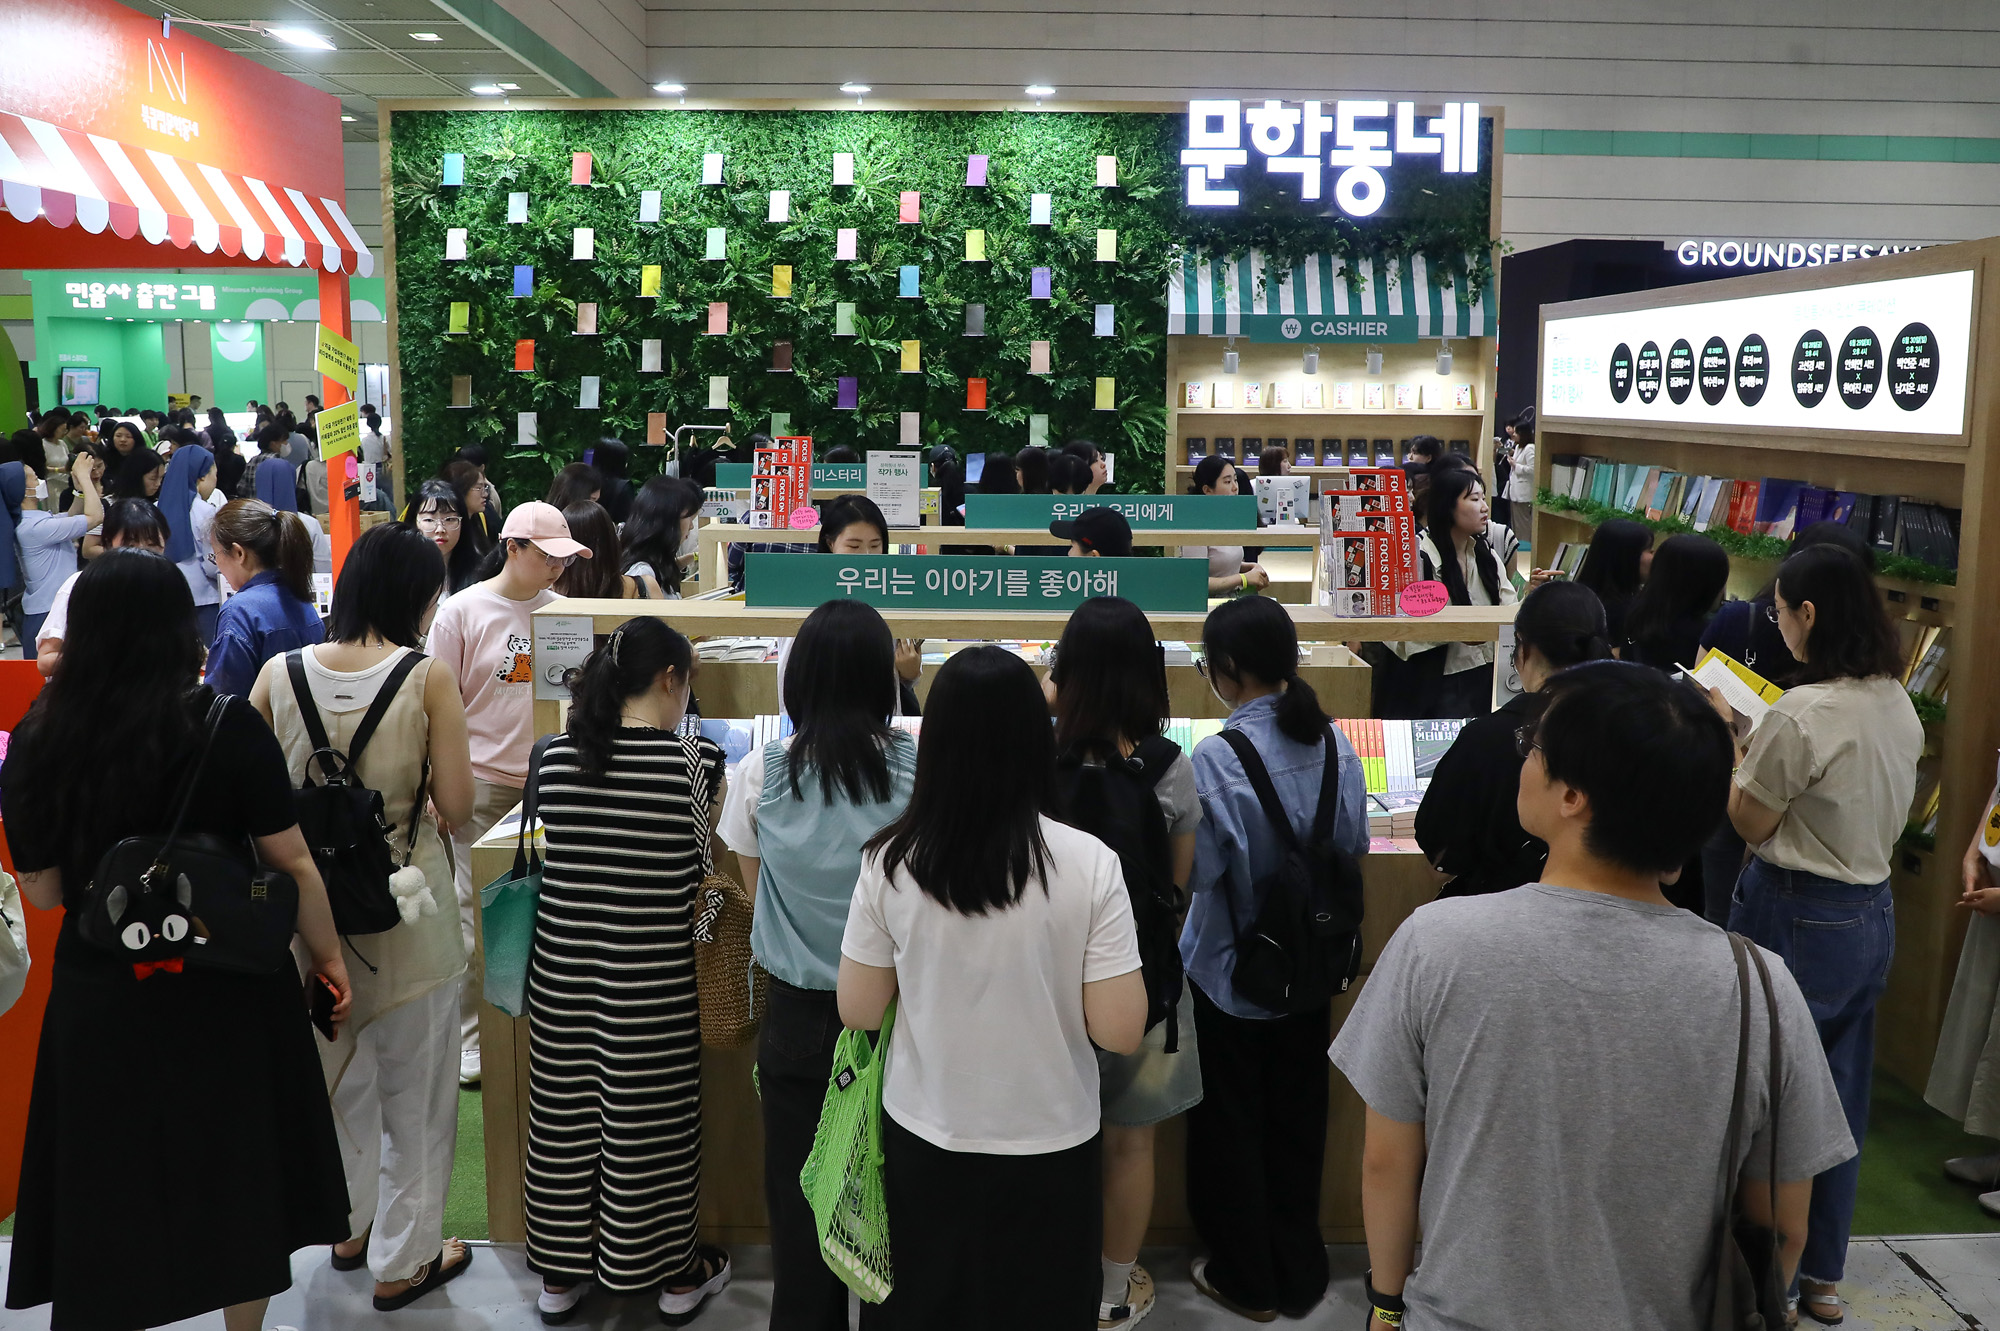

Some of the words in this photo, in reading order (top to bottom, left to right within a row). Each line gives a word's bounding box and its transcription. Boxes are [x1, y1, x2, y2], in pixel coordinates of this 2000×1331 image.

[1180, 100, 1479, 217] 문학동네
[1677, 240, 1921, 267] GROUNDSEES
[65, 282, 131, 308] 민음사
[136, 283, 178, 310] 출판
[181, 285, 216, 310] 그룹
[251, 287, 283, 295] Publishing
[1310, 321, 1388, 337] CASHIER
[814, 469, 862, 483] 미스터리
[878, 468, 892, 477] 작가
[894, 468, 908, 477] 행사
[797, 489, 804, 500] ON
[779, 502, 785, 513] ON
[1400, 516, 1409, 551] FOCUS
[1380, 537, 1389, 572] FOCUS
[1403, 552, 1412, 568] ON
[836, 567, 916, 595] 우리는
[925, 567, 1031, 597] 이야기를
[1038, 569, 1118, 597] 좋아해
[1380, 573, 1390, 591] ON
[1415, 720, 1424, 731] 두
